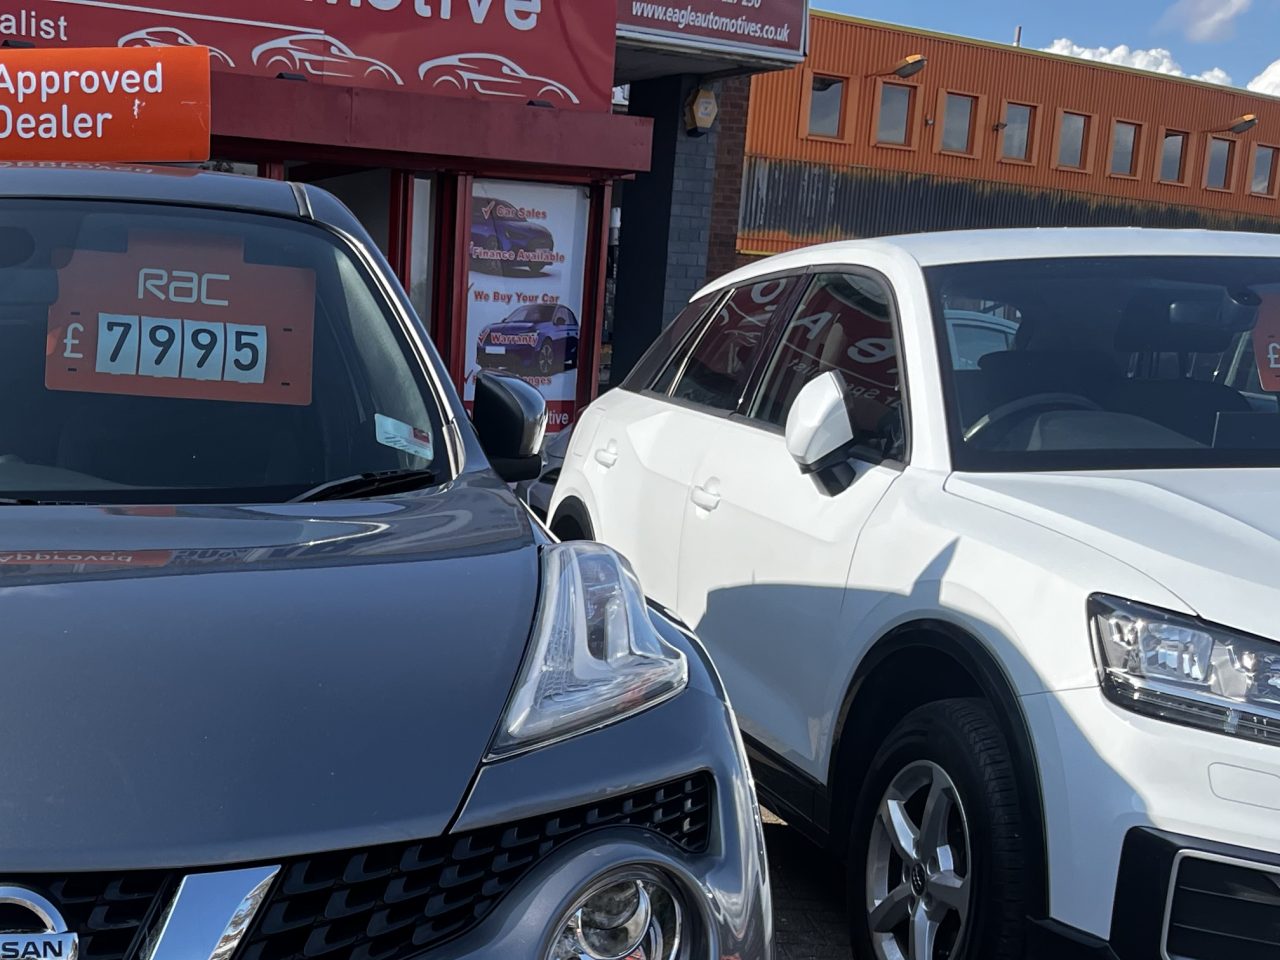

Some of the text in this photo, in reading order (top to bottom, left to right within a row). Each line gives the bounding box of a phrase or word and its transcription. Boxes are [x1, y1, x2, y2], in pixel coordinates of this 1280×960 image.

[632, 1, 790, 42] www.eagleautomotives.co.uk
[496, 205, 547, 219] Car Sales
[473, 246, 565, 263] Finance Available
[474, 291, 560, 304] We Buy Your Car
[63, 321, 259, 372] £ 7995
[490, 332, 538, 346] Warranty
